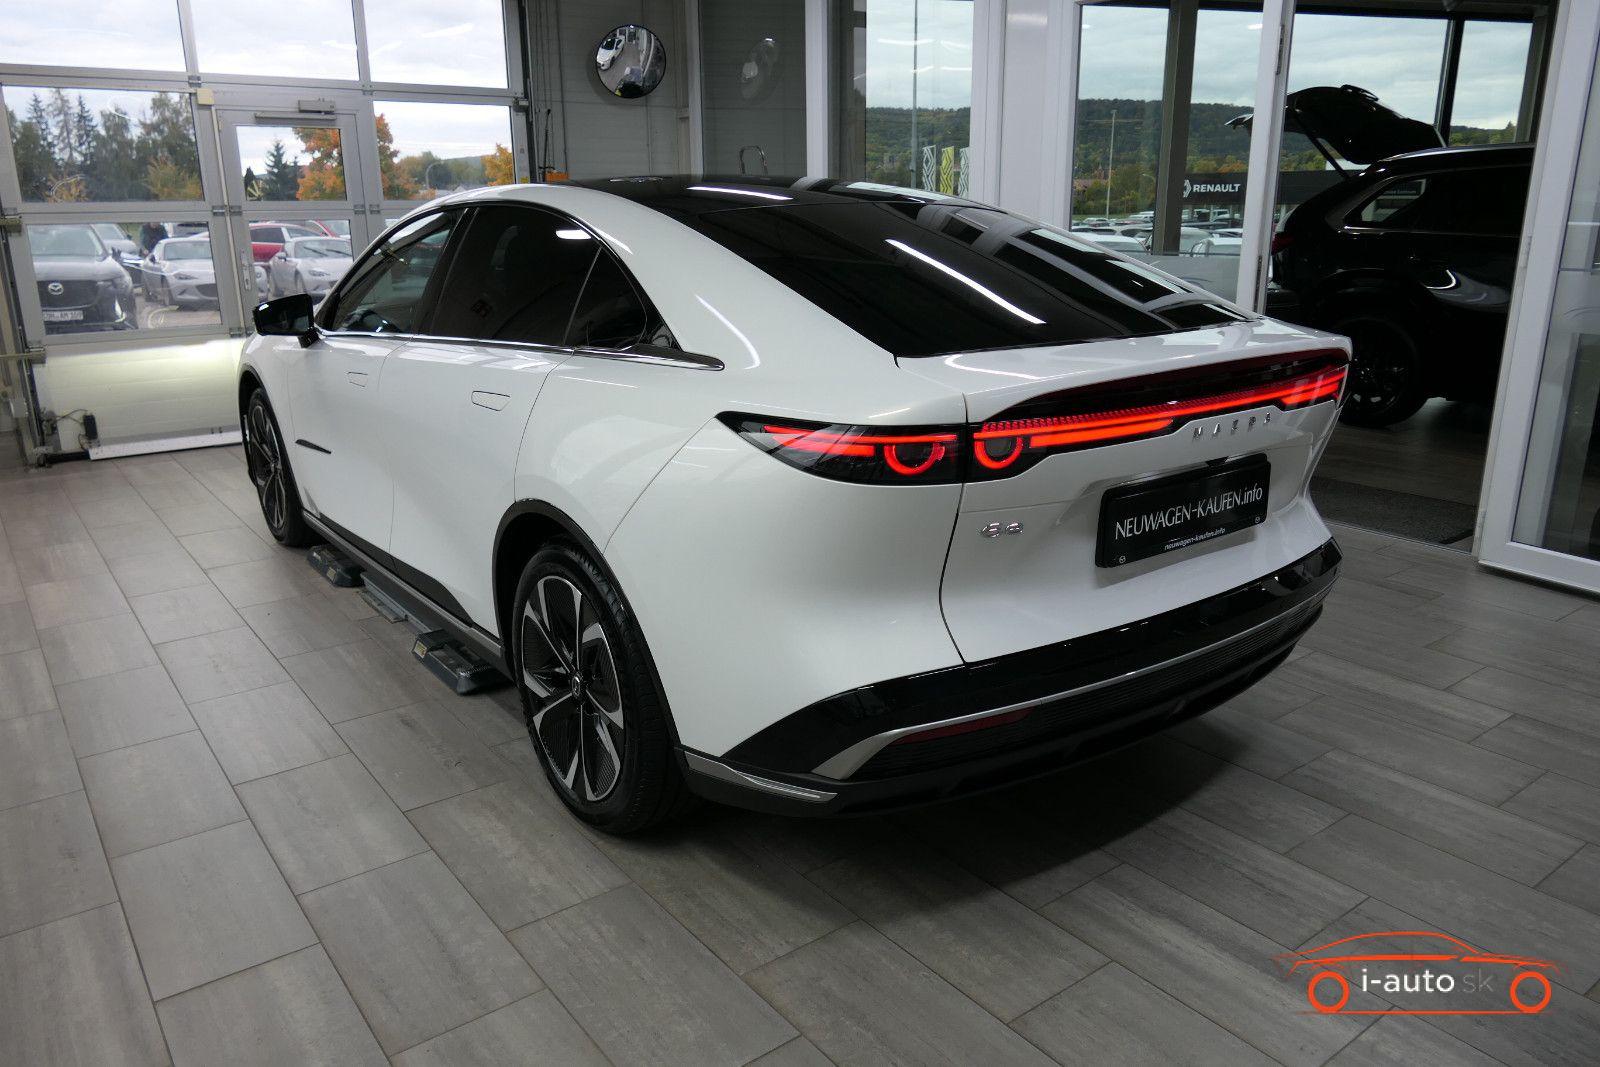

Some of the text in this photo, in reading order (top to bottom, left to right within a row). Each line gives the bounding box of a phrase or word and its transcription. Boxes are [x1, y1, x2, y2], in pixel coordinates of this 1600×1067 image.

[1193, 183, 1241, 193] RENAULT
[1115, 483, 1263, 540] NEUWAGEN-KAUFEN.info
[1164, 527, 1226, 551] neuwagen-kaufen.info
